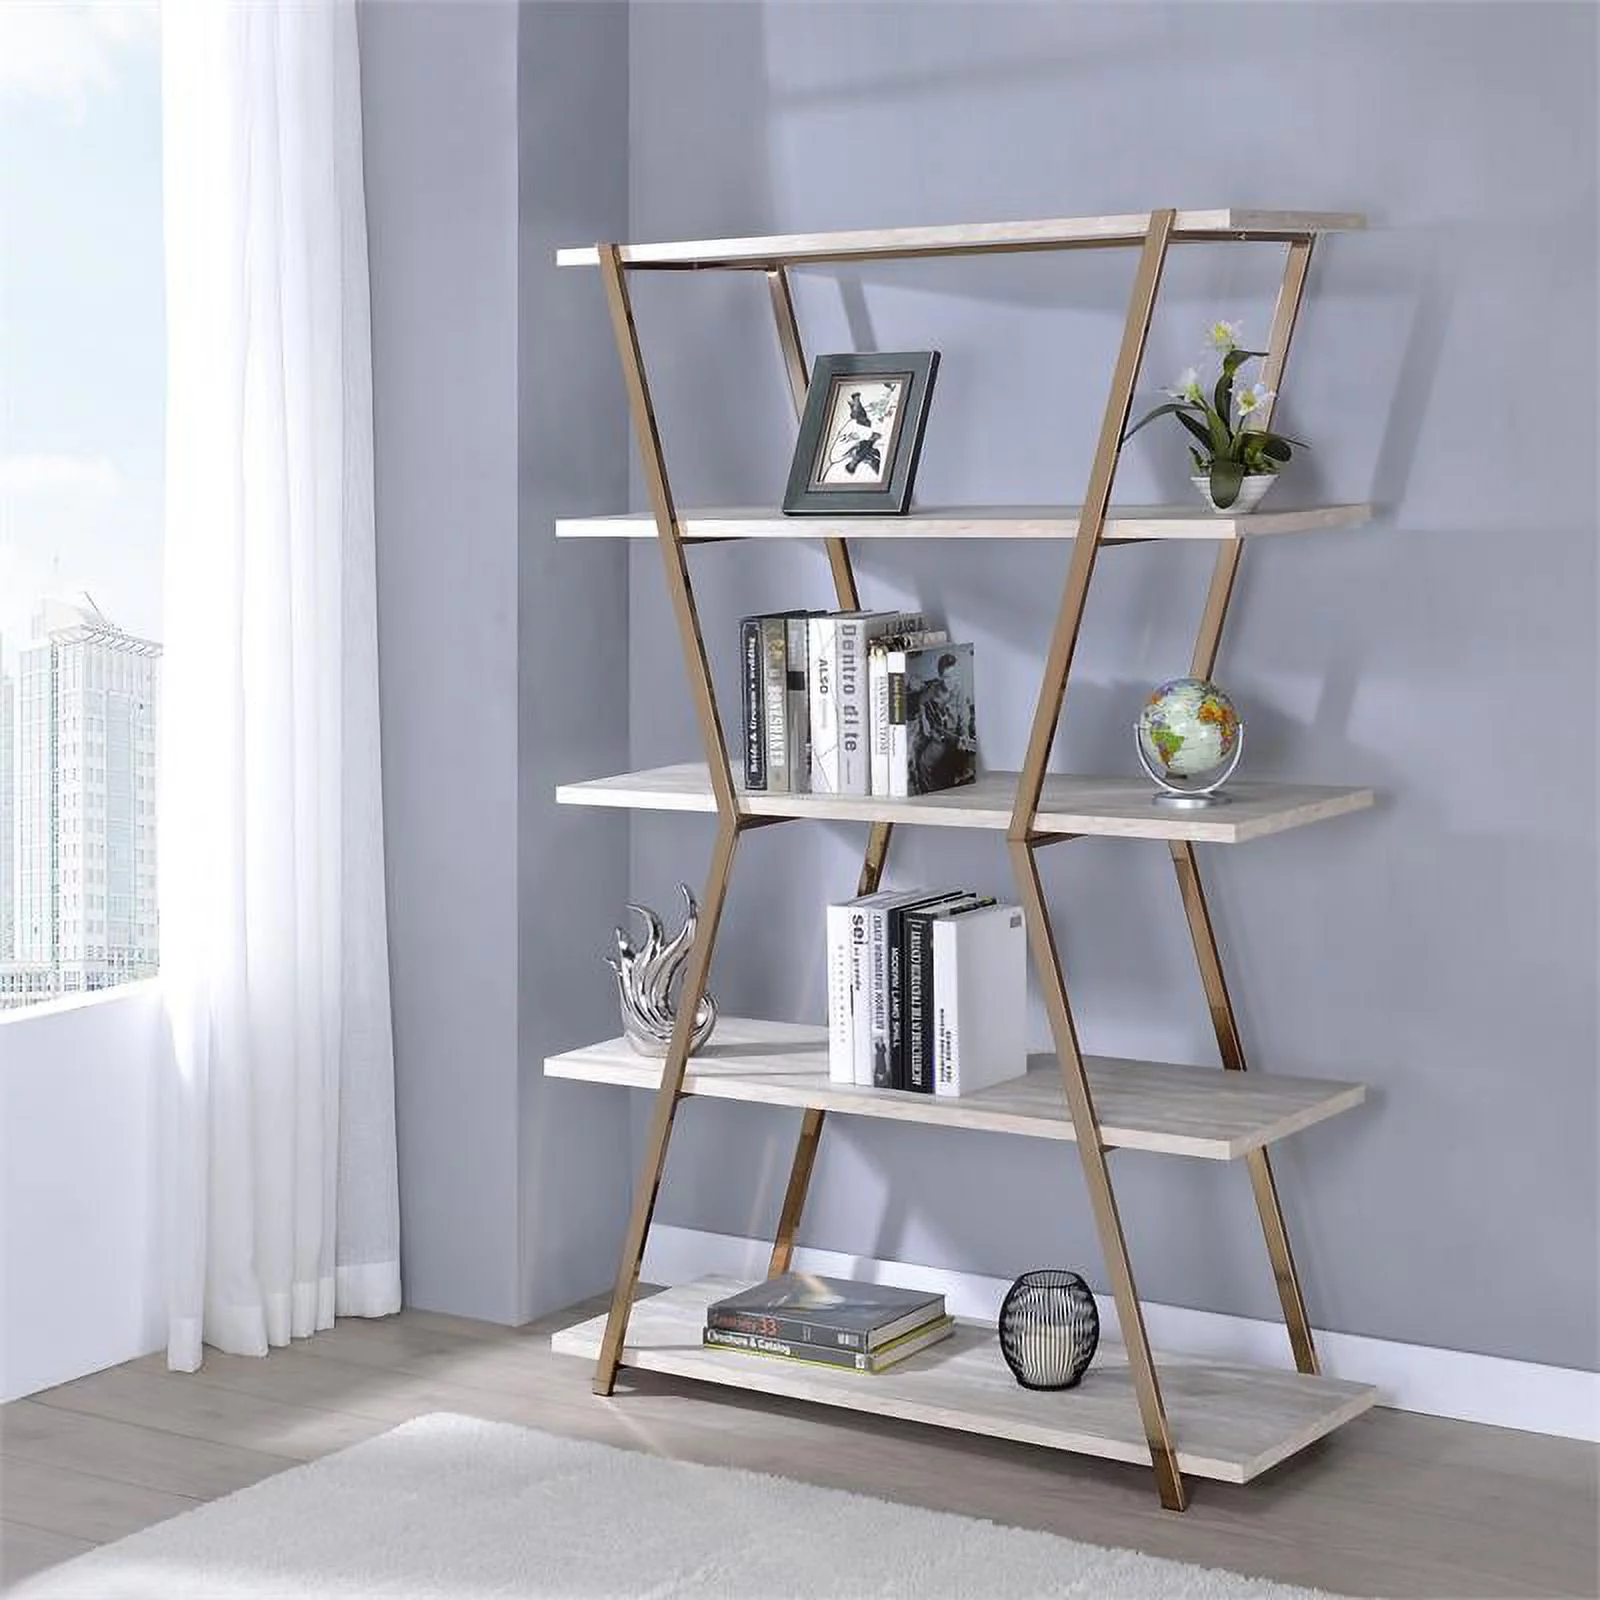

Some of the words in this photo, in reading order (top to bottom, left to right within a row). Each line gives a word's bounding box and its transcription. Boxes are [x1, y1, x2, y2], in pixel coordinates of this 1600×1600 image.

[842, 624, 857, 695] Dentro
[819, 658, 829, 694] ALSO
[844, 704, 859, 725] di
[845, 733, 860, 752] te
